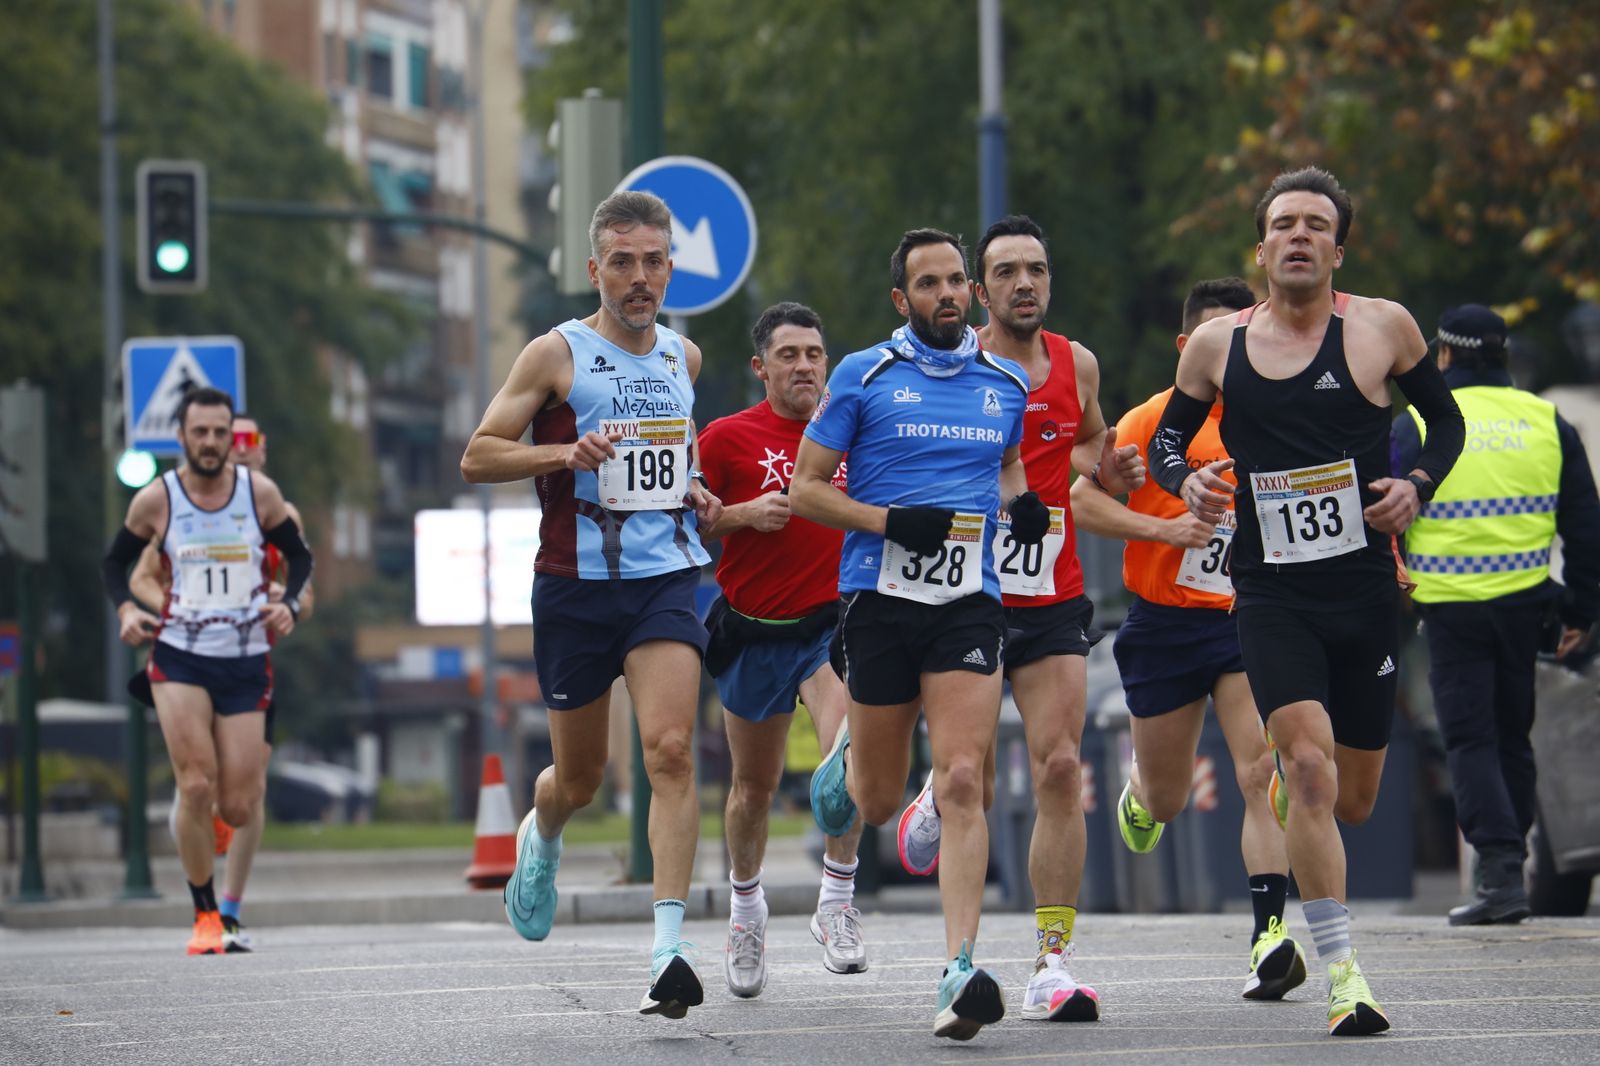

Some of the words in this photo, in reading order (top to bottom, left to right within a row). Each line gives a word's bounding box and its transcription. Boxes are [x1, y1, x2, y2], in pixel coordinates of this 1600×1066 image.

[590, 365, 615, 374] VIATOR
[894, 386, 922, 400] als
[1314, 382, 1340, 390] adidas
[604, 422, 639, 438] XXXIX
[895, 423, 1004, 444] TROTASIERRA
[623, 449, 675, 491] 198
[1255, 475, 1291, 491] XXXIX
[1308, 481, 1353, 495] TRINITARIOS
[1278, 496, 1343, 544] 133
[1000, 534, 1043, 577] 20
[901, 545, 966, 588] 328
[204, 567, 229, 594] 11
[962, 657, 987, 666] adidas
